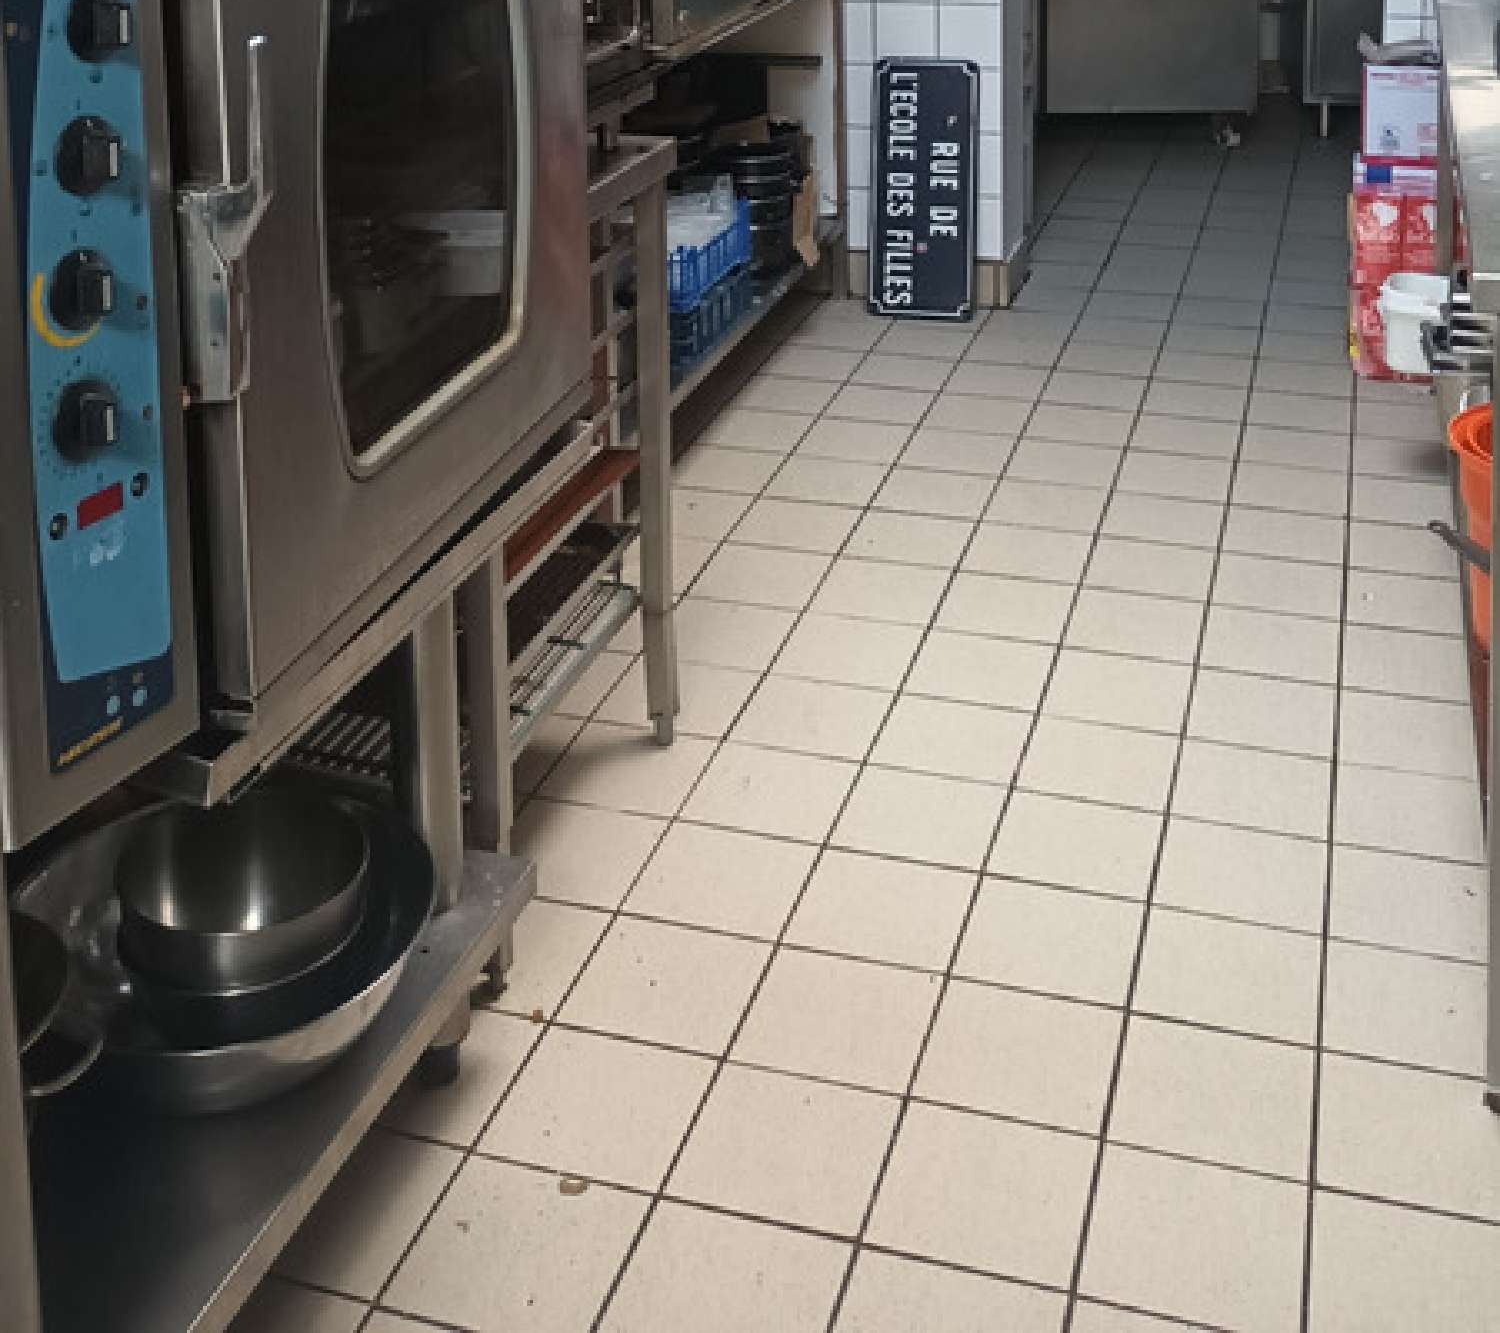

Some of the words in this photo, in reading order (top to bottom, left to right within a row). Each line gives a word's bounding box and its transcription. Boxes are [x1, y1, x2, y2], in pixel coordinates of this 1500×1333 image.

[888, 72, 918, 161] L'ECOLE
[930, 142, 960, 190] RUE
[887, 172, 914, 217] DES
[930, 206, 958, 238] DE
[883, 229, 914, 307] FILLES
